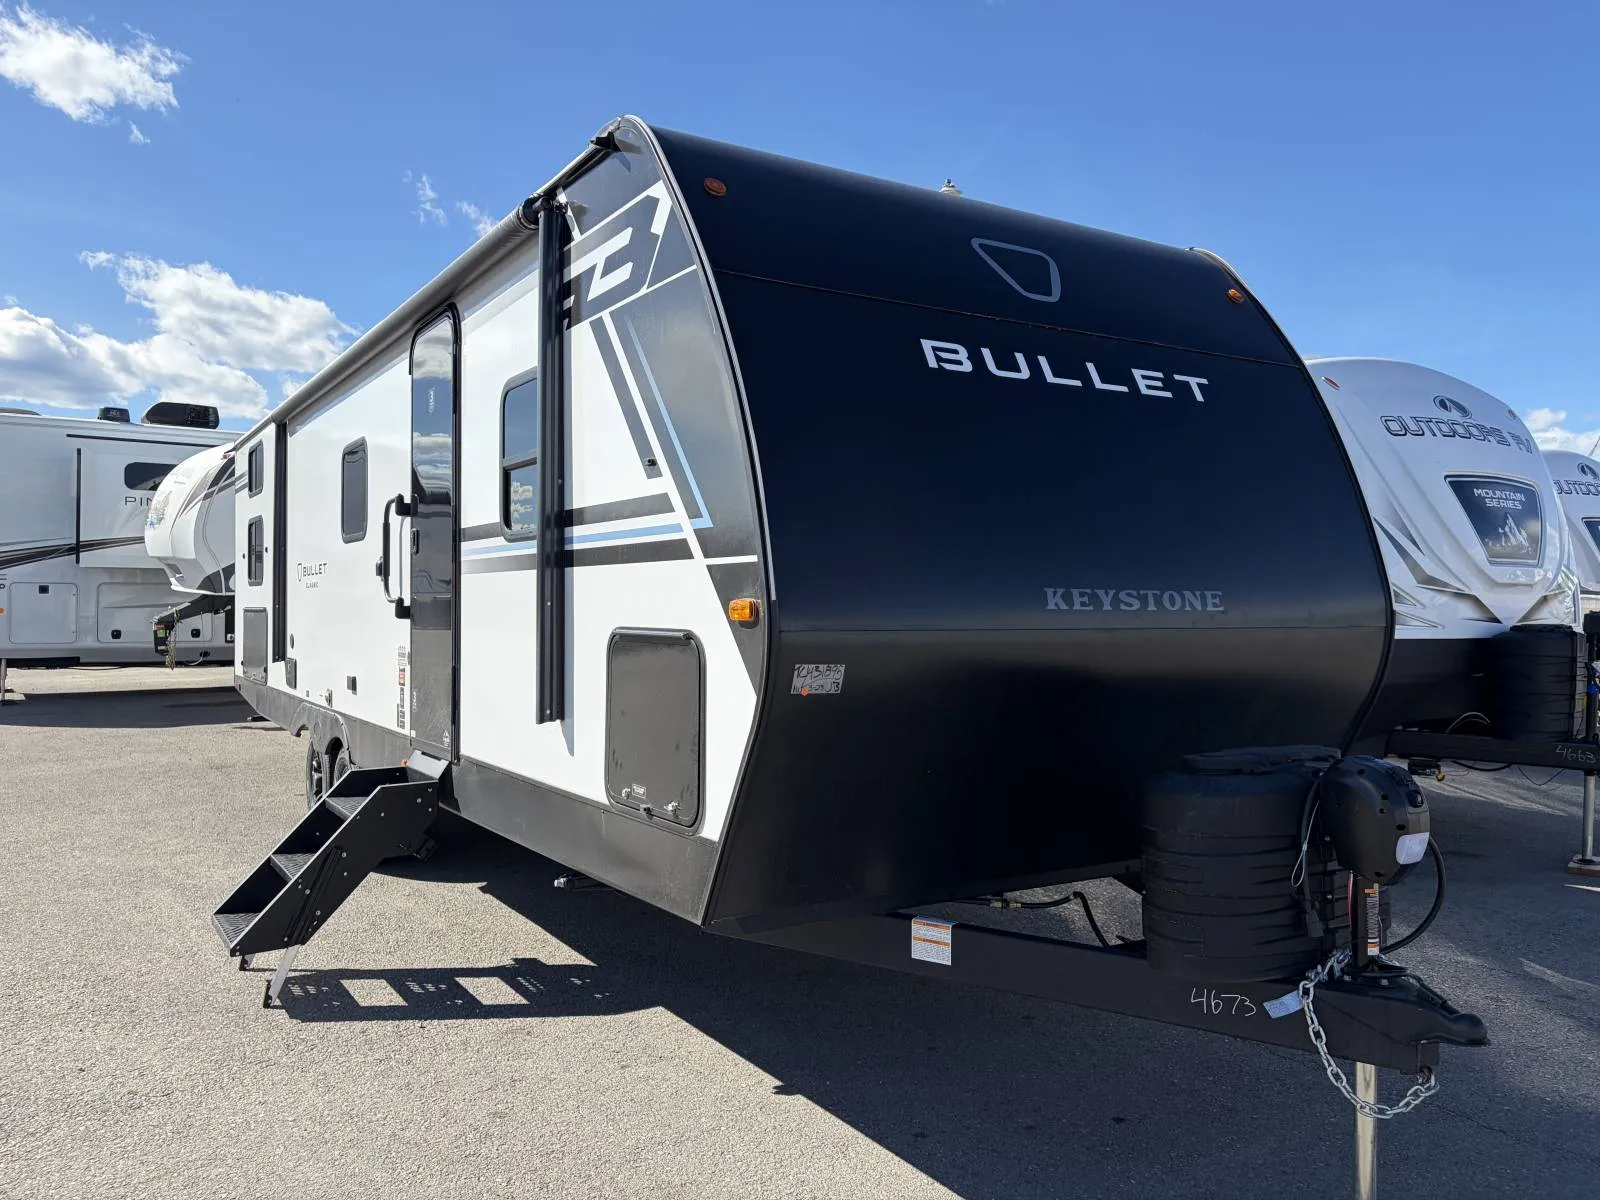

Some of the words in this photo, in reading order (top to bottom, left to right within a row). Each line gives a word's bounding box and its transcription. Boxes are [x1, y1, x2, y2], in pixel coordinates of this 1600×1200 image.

[920, 338, 1209, 403] BULLET
[1380, 415, 1511, 447] OUTDOORS
[1507, 431, 1533, 454] RV
[1473, 488, 1526, 502] MOUNTAIN
[1486, 498, 1522, 510] SERIES
[302, 562, 328, 578] BULLET
[1044, 587, 1225, 611] KEYSTONE
[1190, 987, 1257, 1017] 4673
